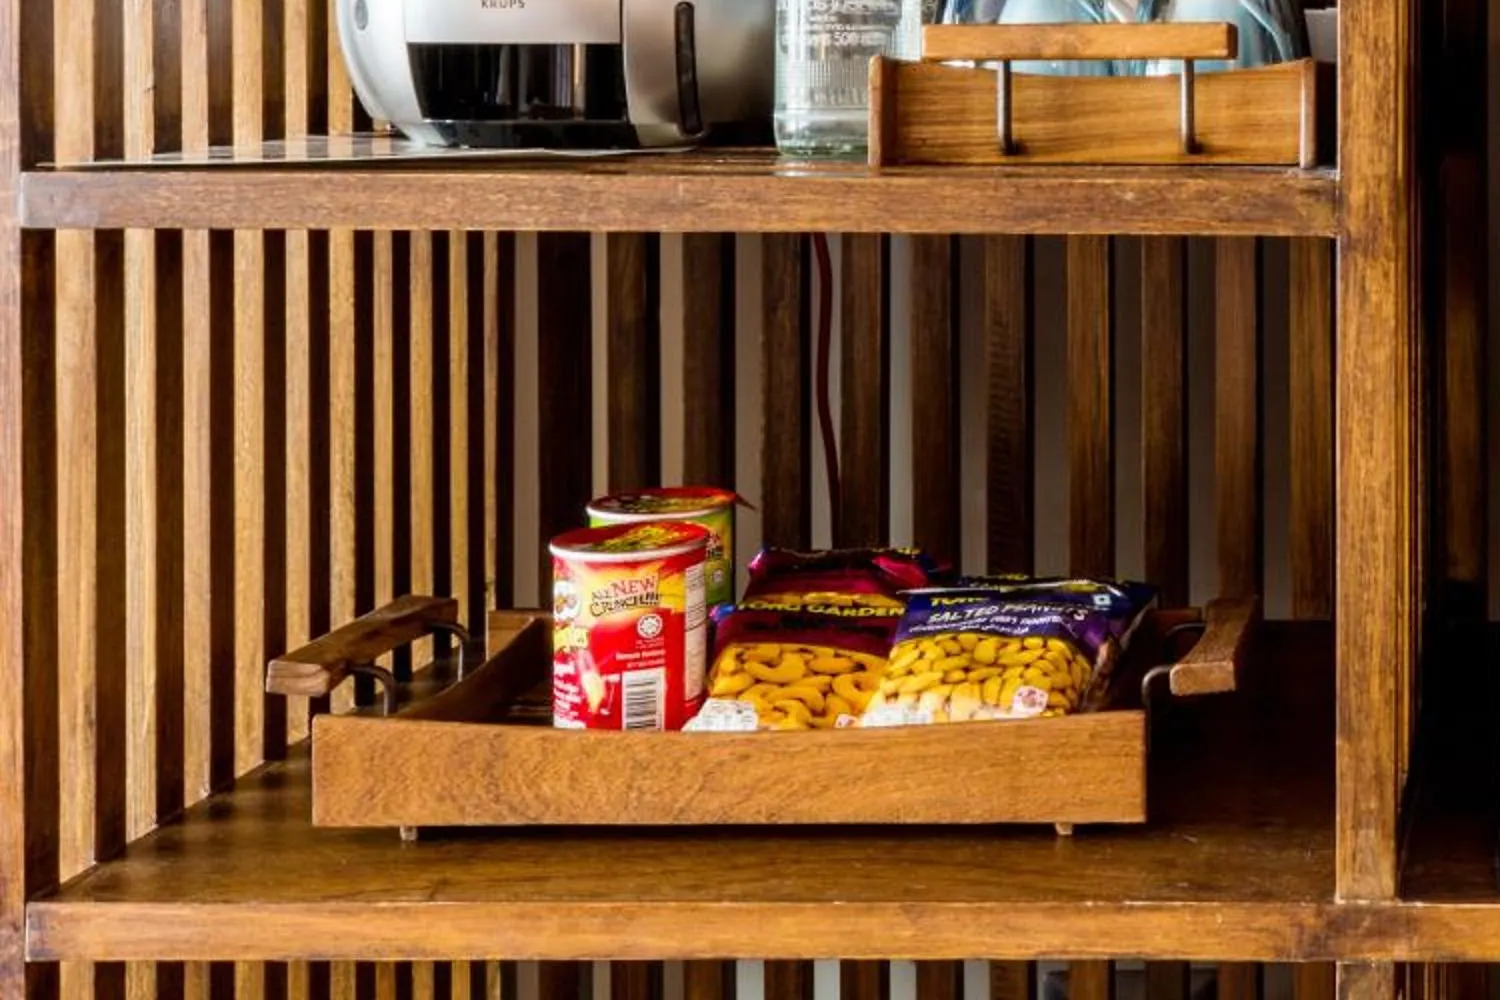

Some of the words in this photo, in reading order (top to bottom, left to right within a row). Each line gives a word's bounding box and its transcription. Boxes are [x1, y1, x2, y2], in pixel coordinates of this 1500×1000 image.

[610, 575, 658, 595] NEW
[806, 603, 906, 617] GARDEN
[928, 605, 999, 623] SALTED
